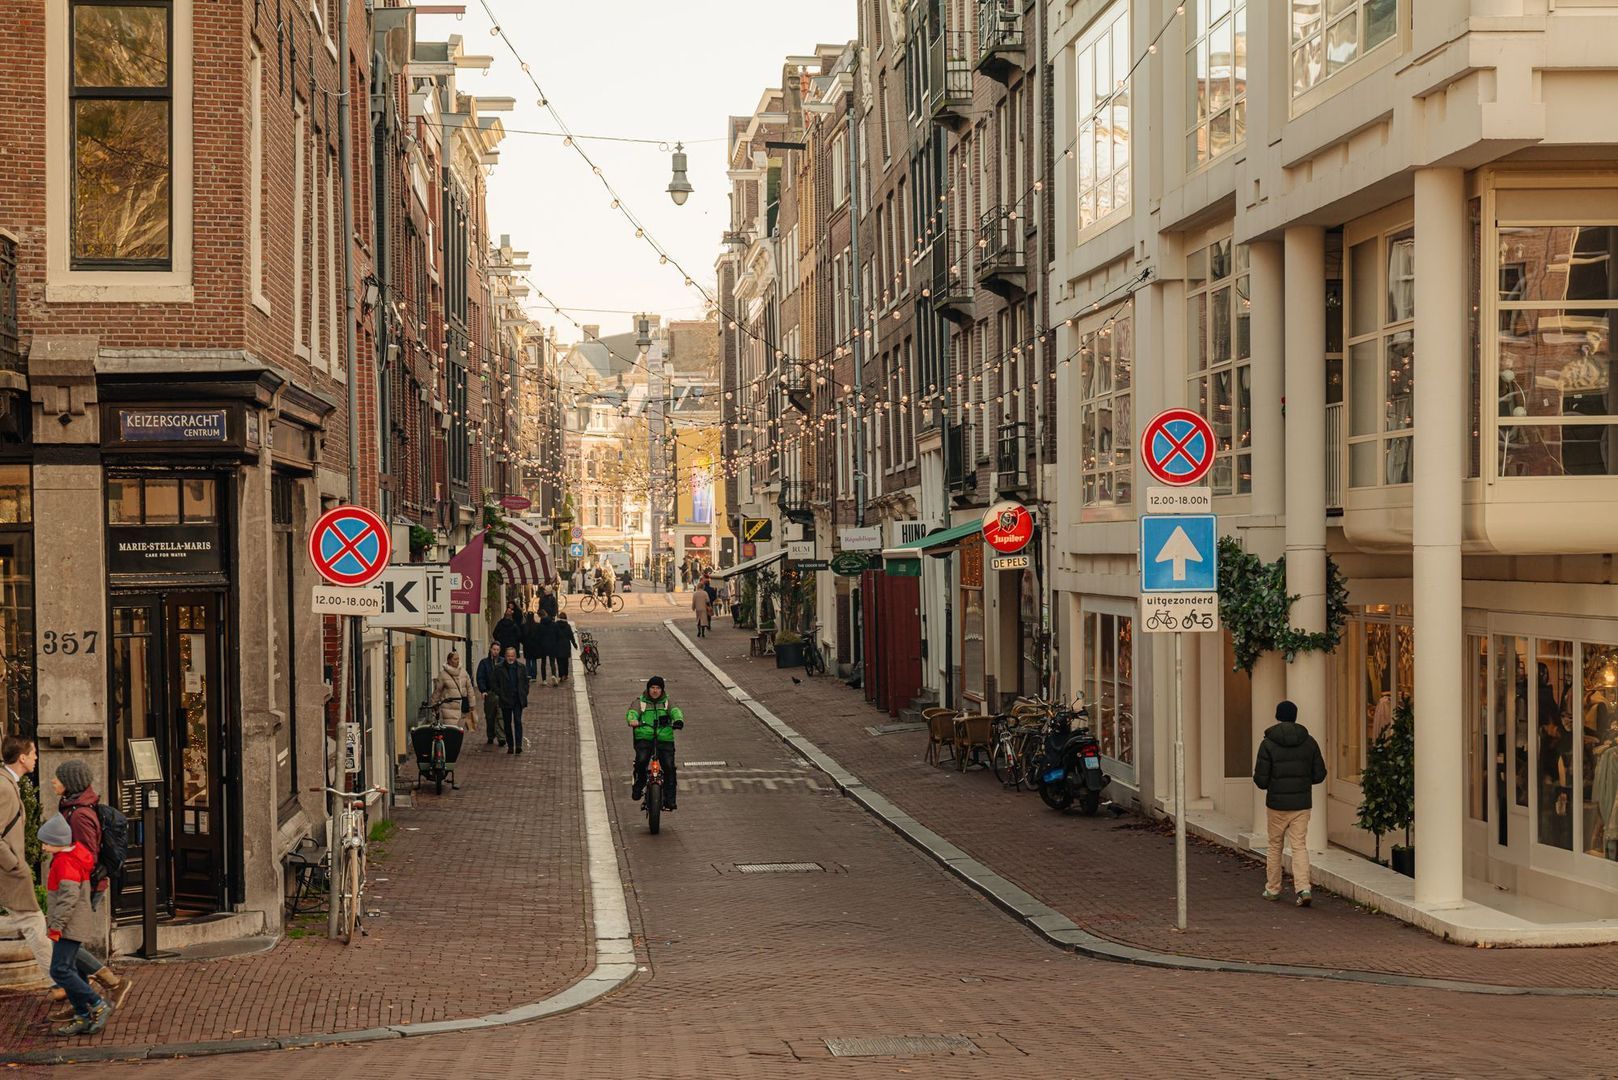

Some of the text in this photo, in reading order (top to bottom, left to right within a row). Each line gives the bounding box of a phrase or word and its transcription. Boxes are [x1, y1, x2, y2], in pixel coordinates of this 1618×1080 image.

[126, 414, 219, 428] KEIZERSGRACHT
[183, 428, 220, 438] CENTRUM
[1150, 496, 1209, 505] 12.00-18.00h
[993, 534, 1025, 544] Jupiler
[118, 542, 212, 551] MARIE-STELLA-MARIS
[993, 557, 1028, 568] DE PELS
[315, 595, 379, 608] 12.00-18.00h
[1146, 595, 1213, 607] uitgezonderd
[42, 630, 98, 655] 357
